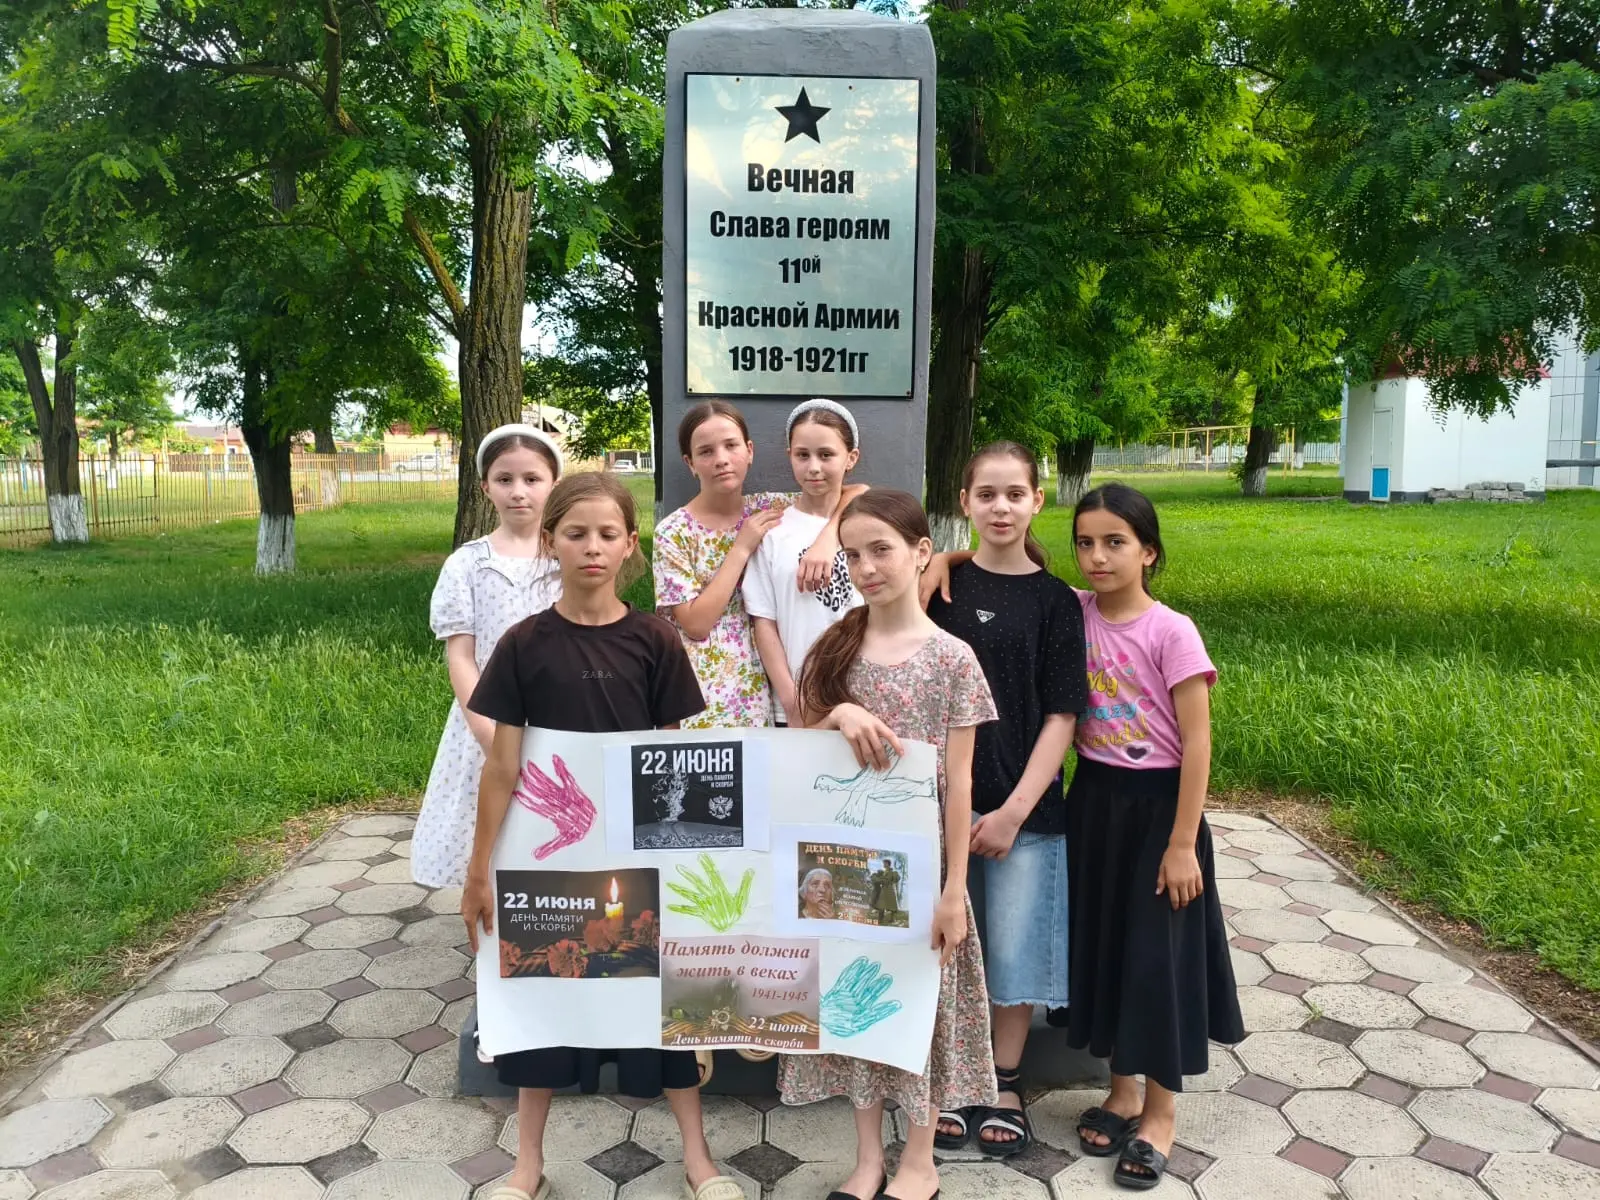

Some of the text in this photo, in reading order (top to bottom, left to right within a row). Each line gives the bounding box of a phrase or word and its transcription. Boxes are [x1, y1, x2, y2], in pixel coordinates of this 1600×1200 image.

[747, 163, 854, 194] Вечная
[710, 210, 890, 242] Слава героям
[778, 255, 821, 284] 11ой
[698, 301, 900, 331] Красной Армии
[729, 346, 869, 373] 1918-1921гг
[582, 670, 614, 680] ZARA
[640, 748, 734, 775] 22 ИЮНЯ
[805, 844, 833, 853] ДЕНЬ
[503, 892, 596, 910] 22 июня
[510, 913, 584, 923] ДЕНЬ ПАМЯТИ
[523, 923, 575, 932] И СКОРБИ
[662, 940, 810, 959] Память должна
[676, 965, 798, 980] жить в веках
[752, 987, 809, 1001] 1941-1945
[748, 1016, 808, 1033] 22 июня
[670, 1033, 701, 1045] День
[703, 1034, 752, 1044] памяти
[764, 1036, 804, 1049] скорби
